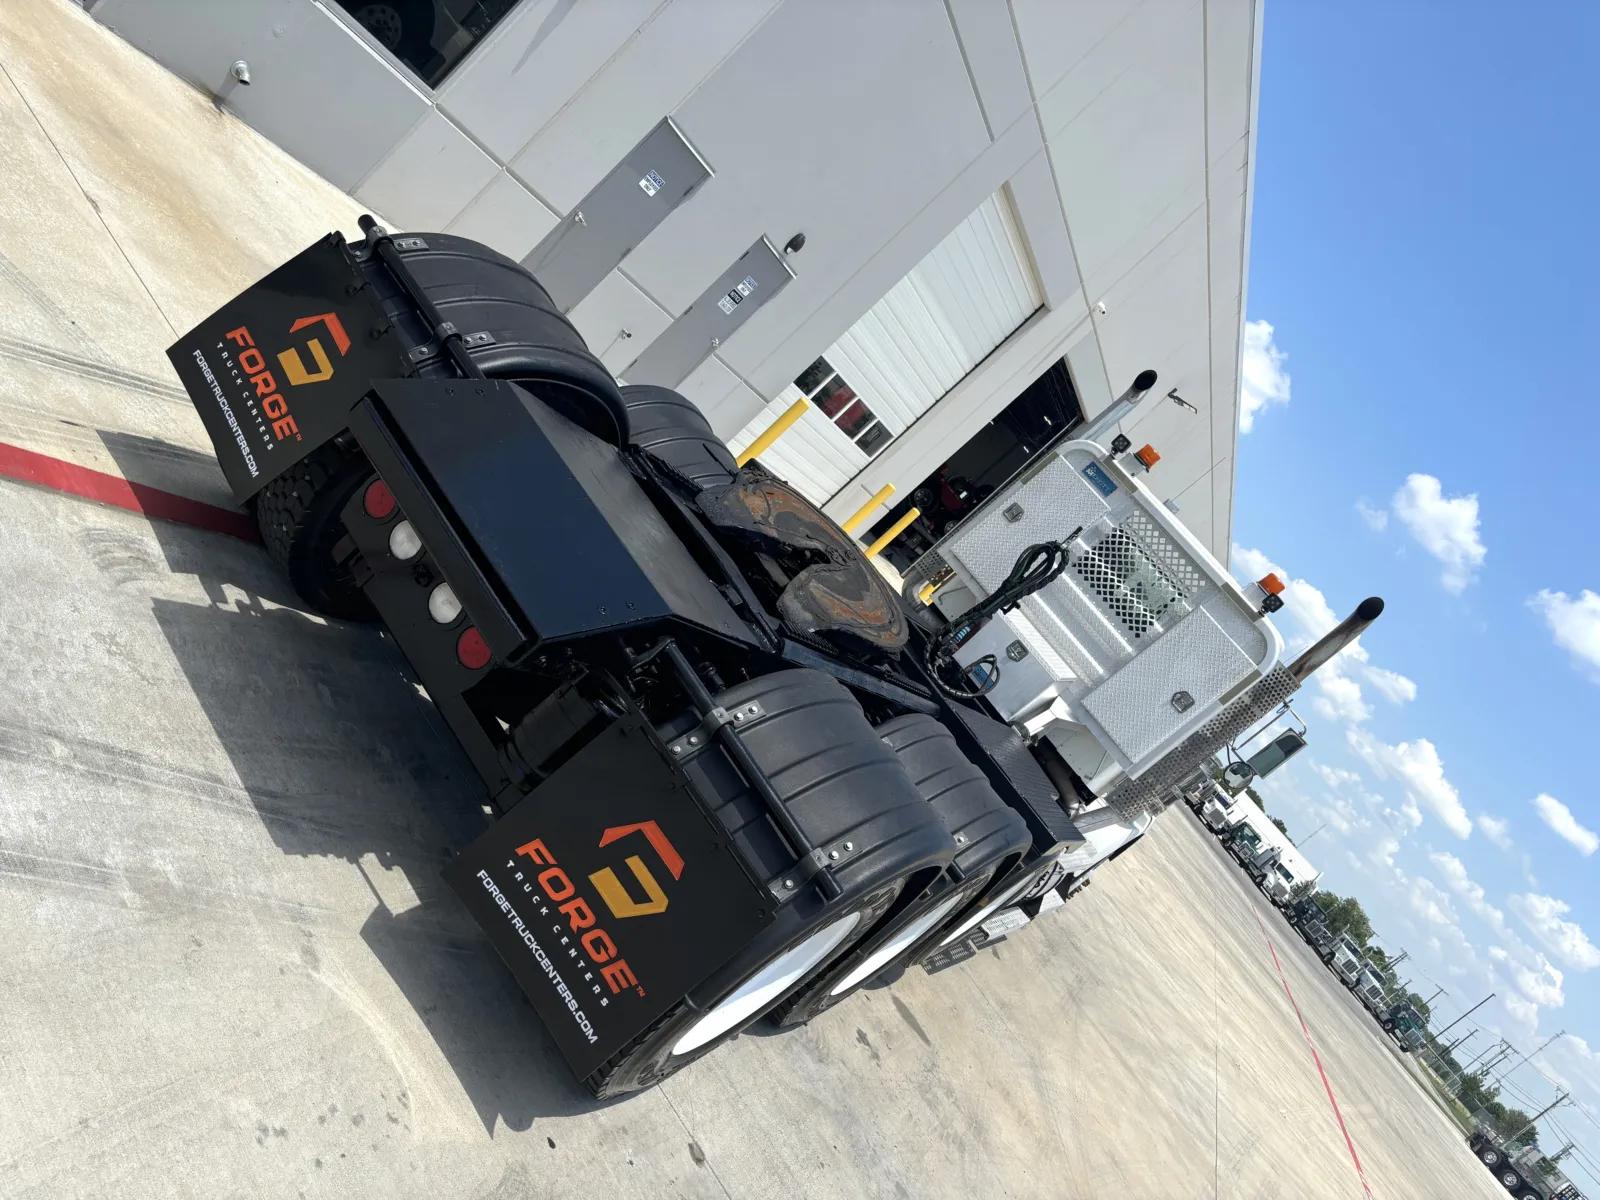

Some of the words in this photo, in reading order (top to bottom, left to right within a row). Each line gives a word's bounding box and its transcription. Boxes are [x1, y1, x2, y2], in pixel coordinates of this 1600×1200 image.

[192, 349, 260, 478] FORGETRUCKCENTERS.COM
[216, 341, 244, 386] TRUCK
[242, 391, 274, 451] CENTERS
[225, 326, 299, 441] FORGE
[476, 868, 599, 1044] FORGETRUCKCENTERS.COM
[506, 859, 549, 917] TRUCK
[552, 924, 609, 1007] CENTERS
[514, 838, 638, 995] FORGE
